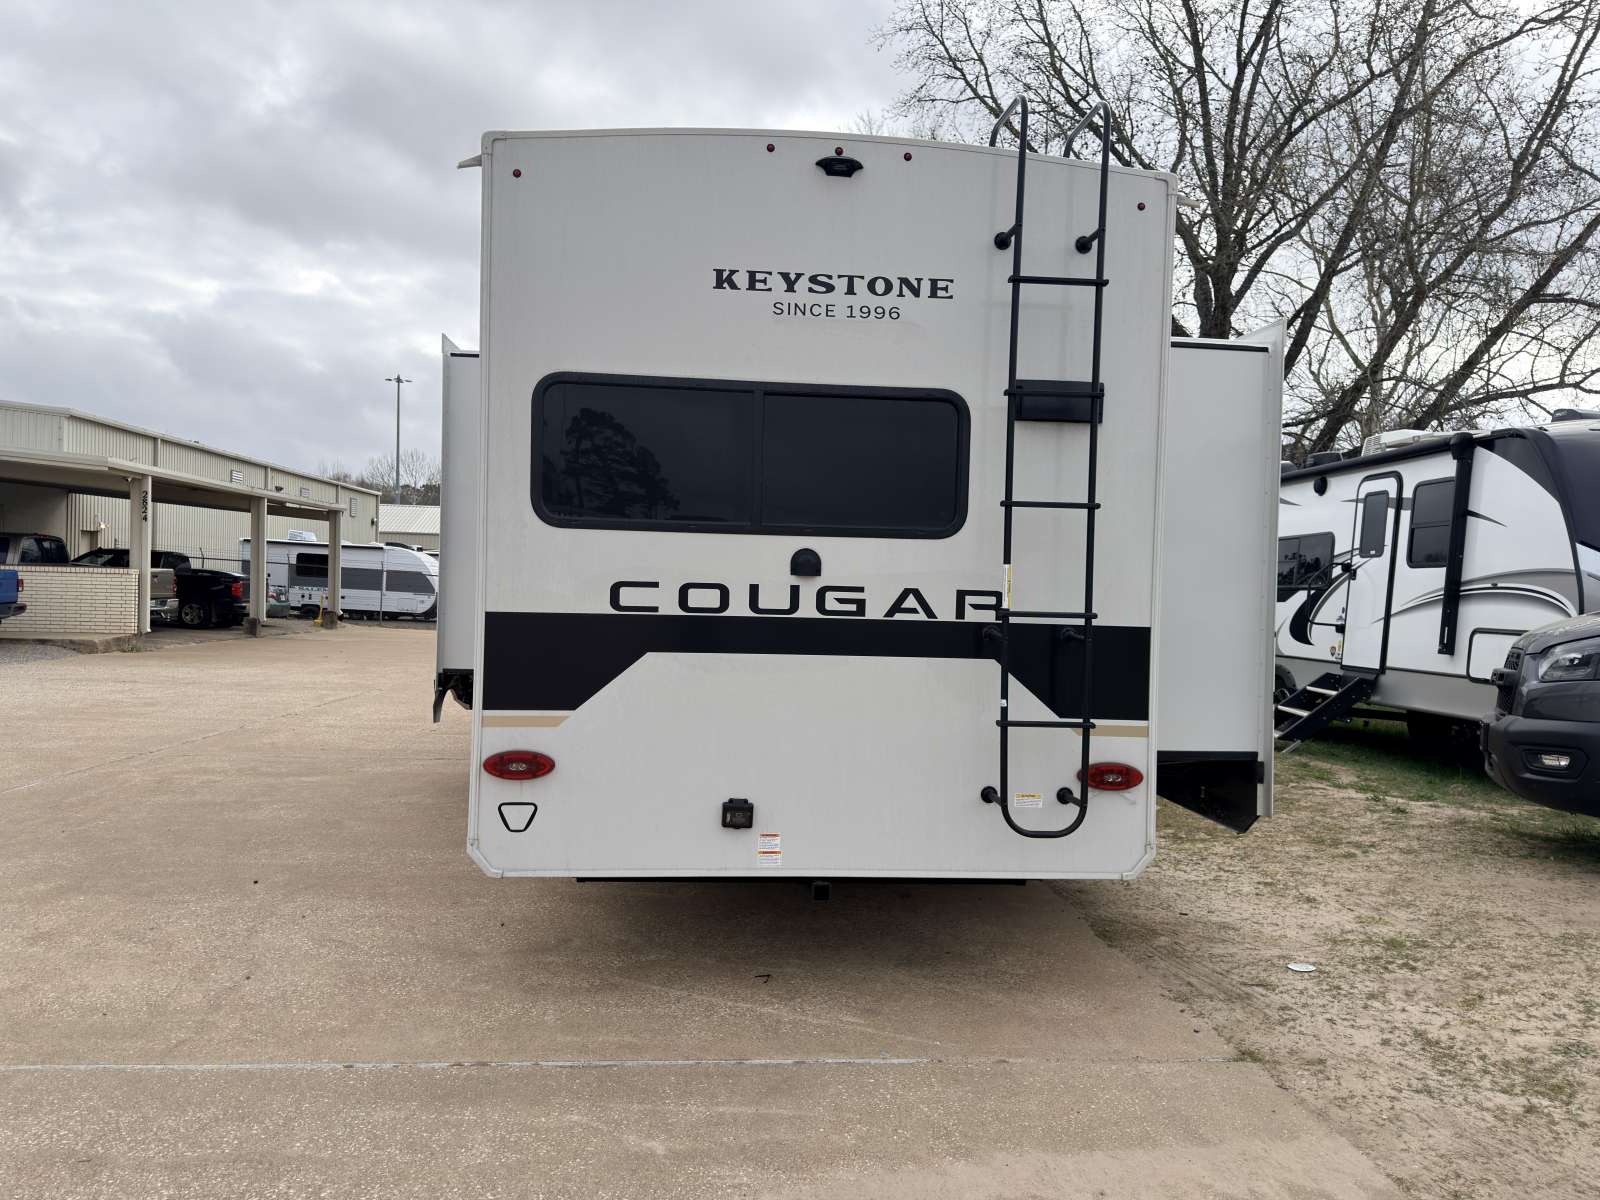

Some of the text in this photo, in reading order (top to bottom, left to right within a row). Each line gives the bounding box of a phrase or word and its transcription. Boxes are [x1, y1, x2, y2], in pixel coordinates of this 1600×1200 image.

[712, 268, 955, 300] KEYSTONE
[772, 301, 901, 320] SINCE 1996
[141, 490, 149, 522] 2824
[610, 580, 1004, 622] COUGAR
